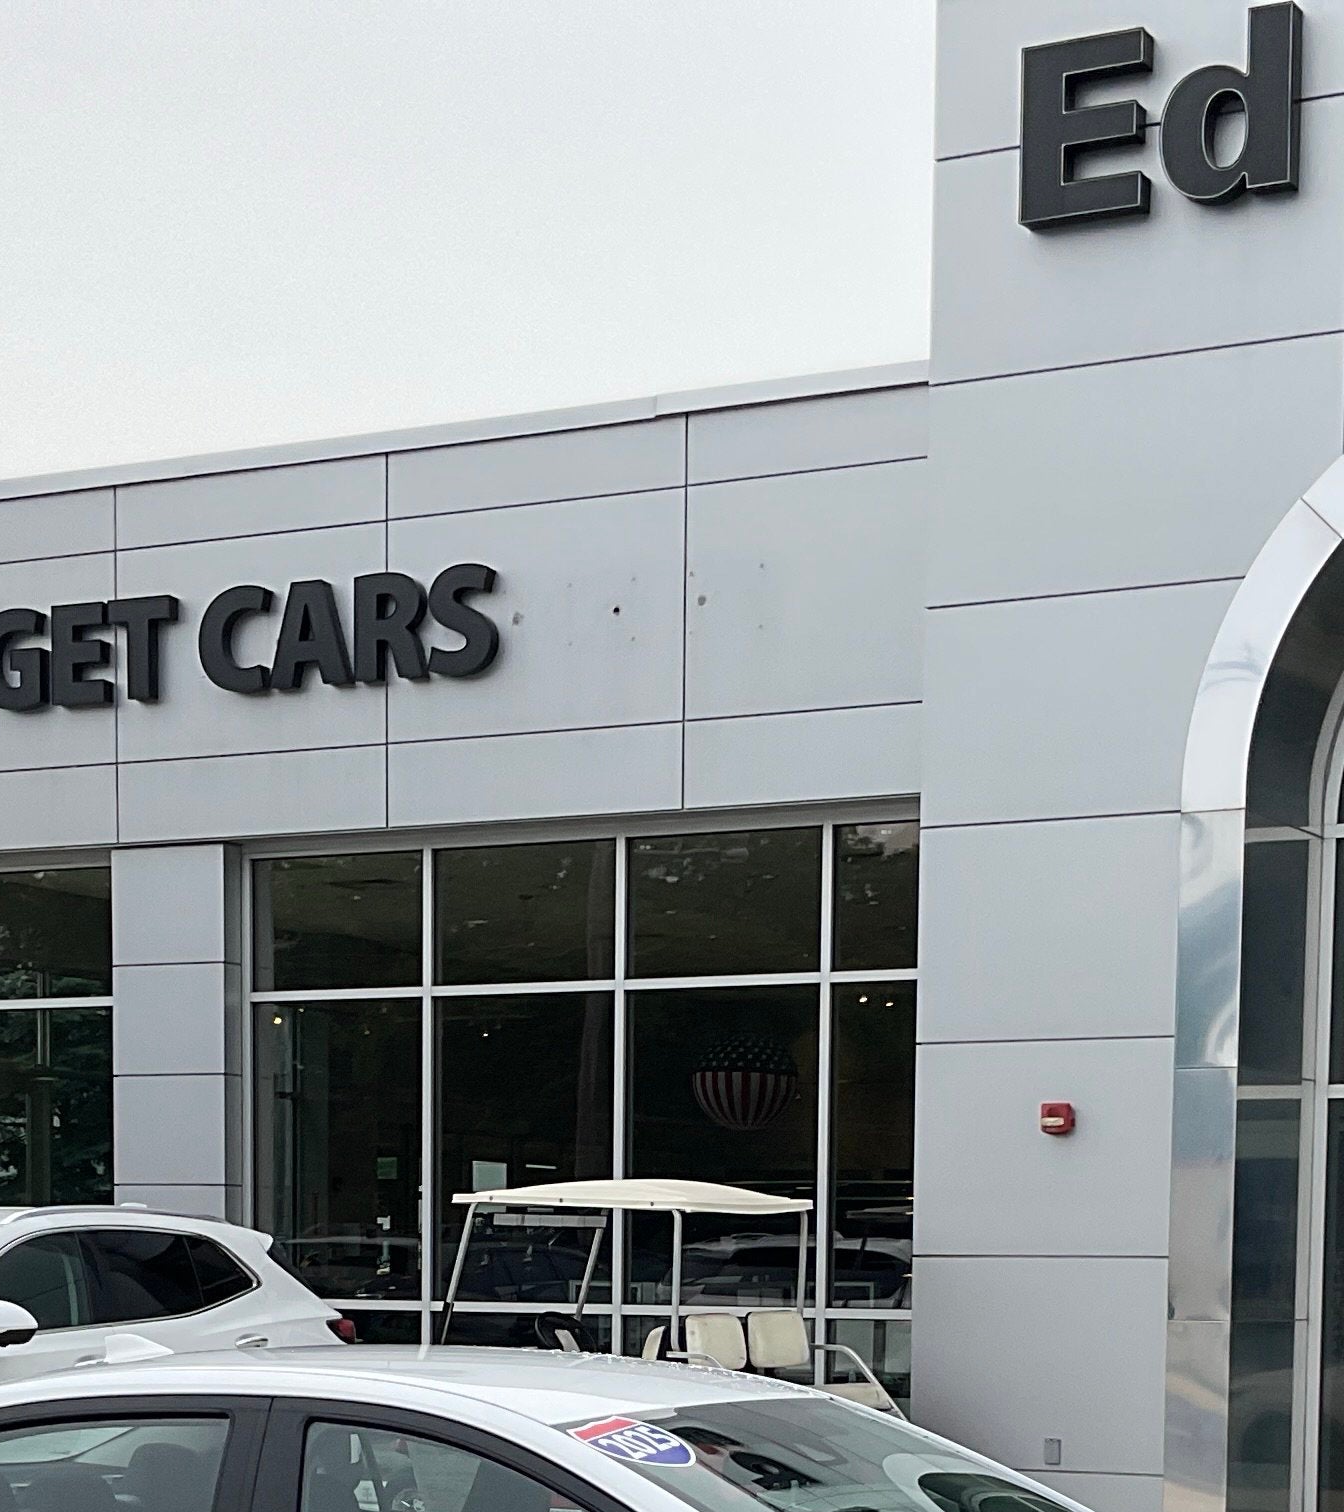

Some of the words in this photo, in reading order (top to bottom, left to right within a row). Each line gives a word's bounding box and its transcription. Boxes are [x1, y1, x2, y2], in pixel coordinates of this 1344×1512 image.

[1017, 0, 1303, 231] Ed
[198, 563, 500, 694] CARS
[597, 1424, 681, 1460] 2025
